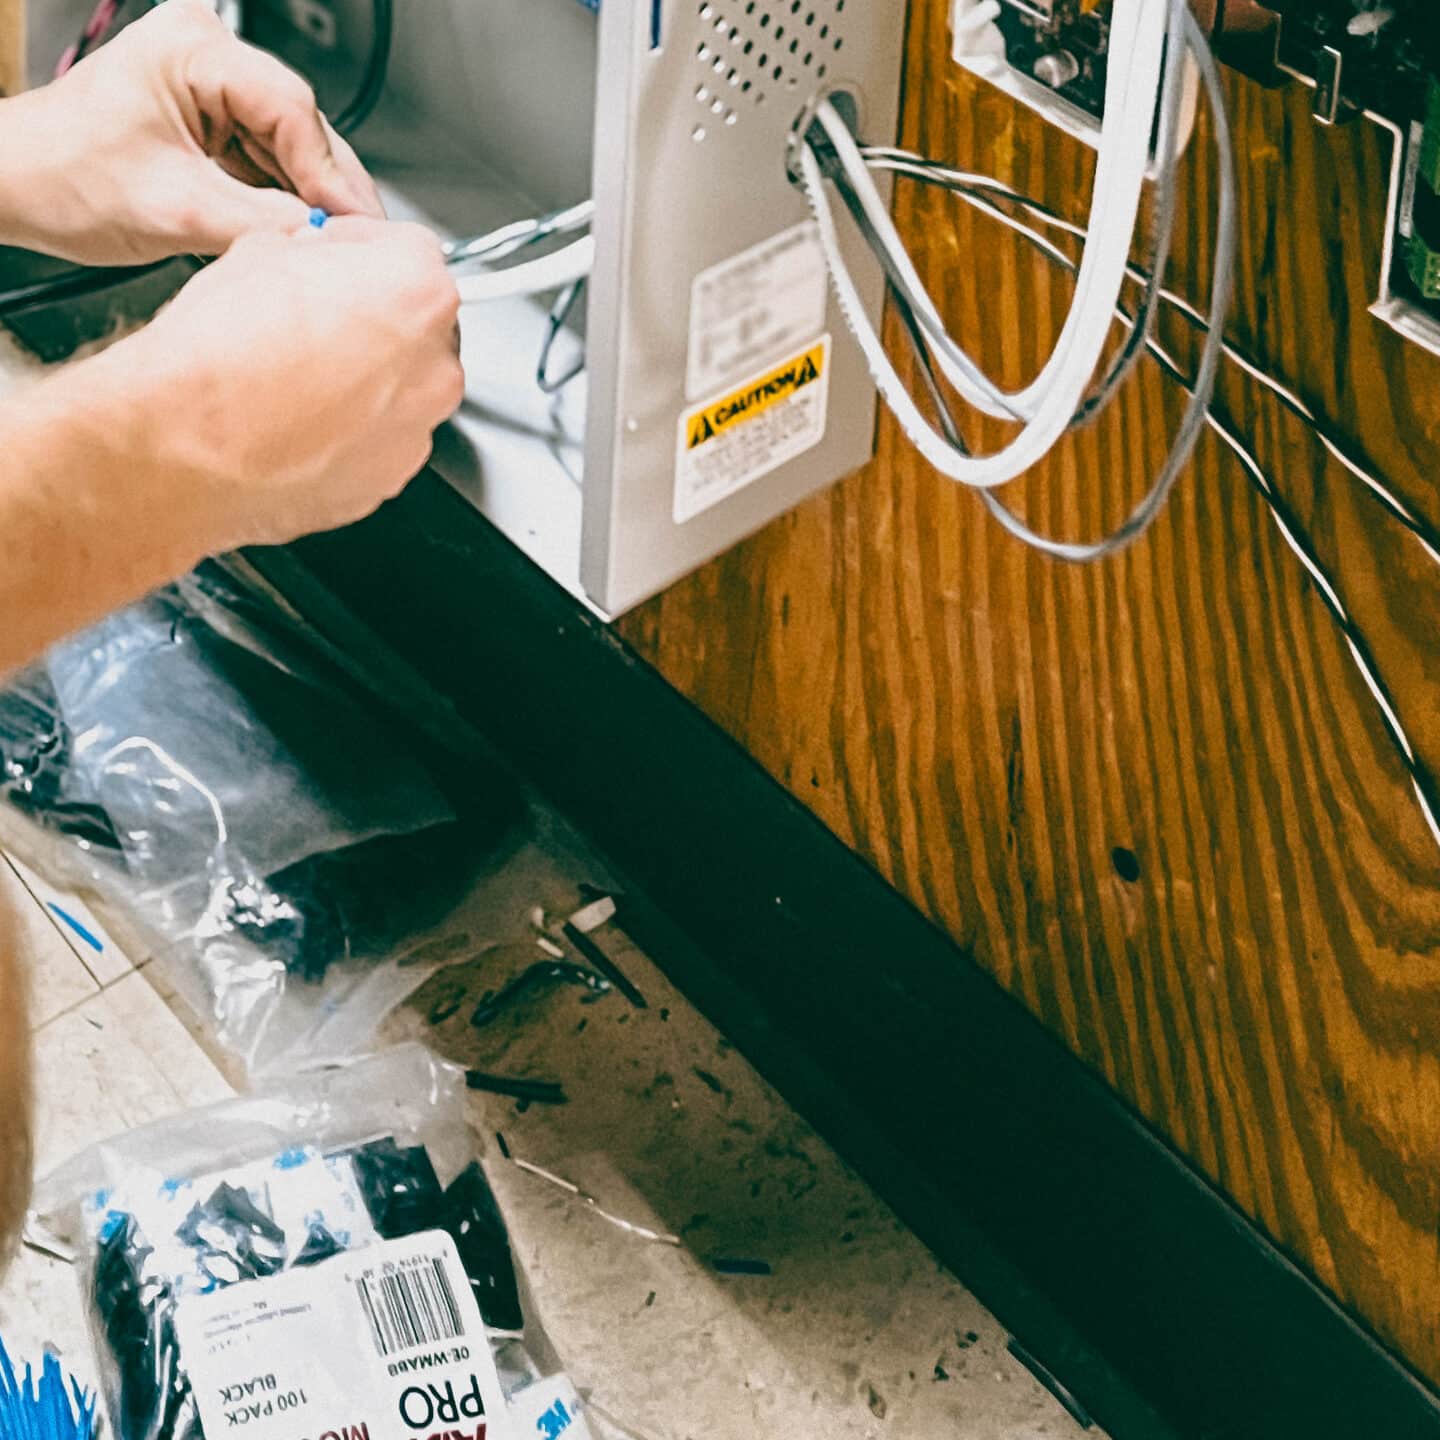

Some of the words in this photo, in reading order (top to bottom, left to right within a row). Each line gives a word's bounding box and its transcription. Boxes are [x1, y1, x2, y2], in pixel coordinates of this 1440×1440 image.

[715, 367, 796, 425] CAUTION
[219, 1373, 277, 1405] BLACK
[277, 1389, 307, 1411] 100
[399, 1374, 486, 1429] PRO
[224, 1400, 273, 1427] PACK
